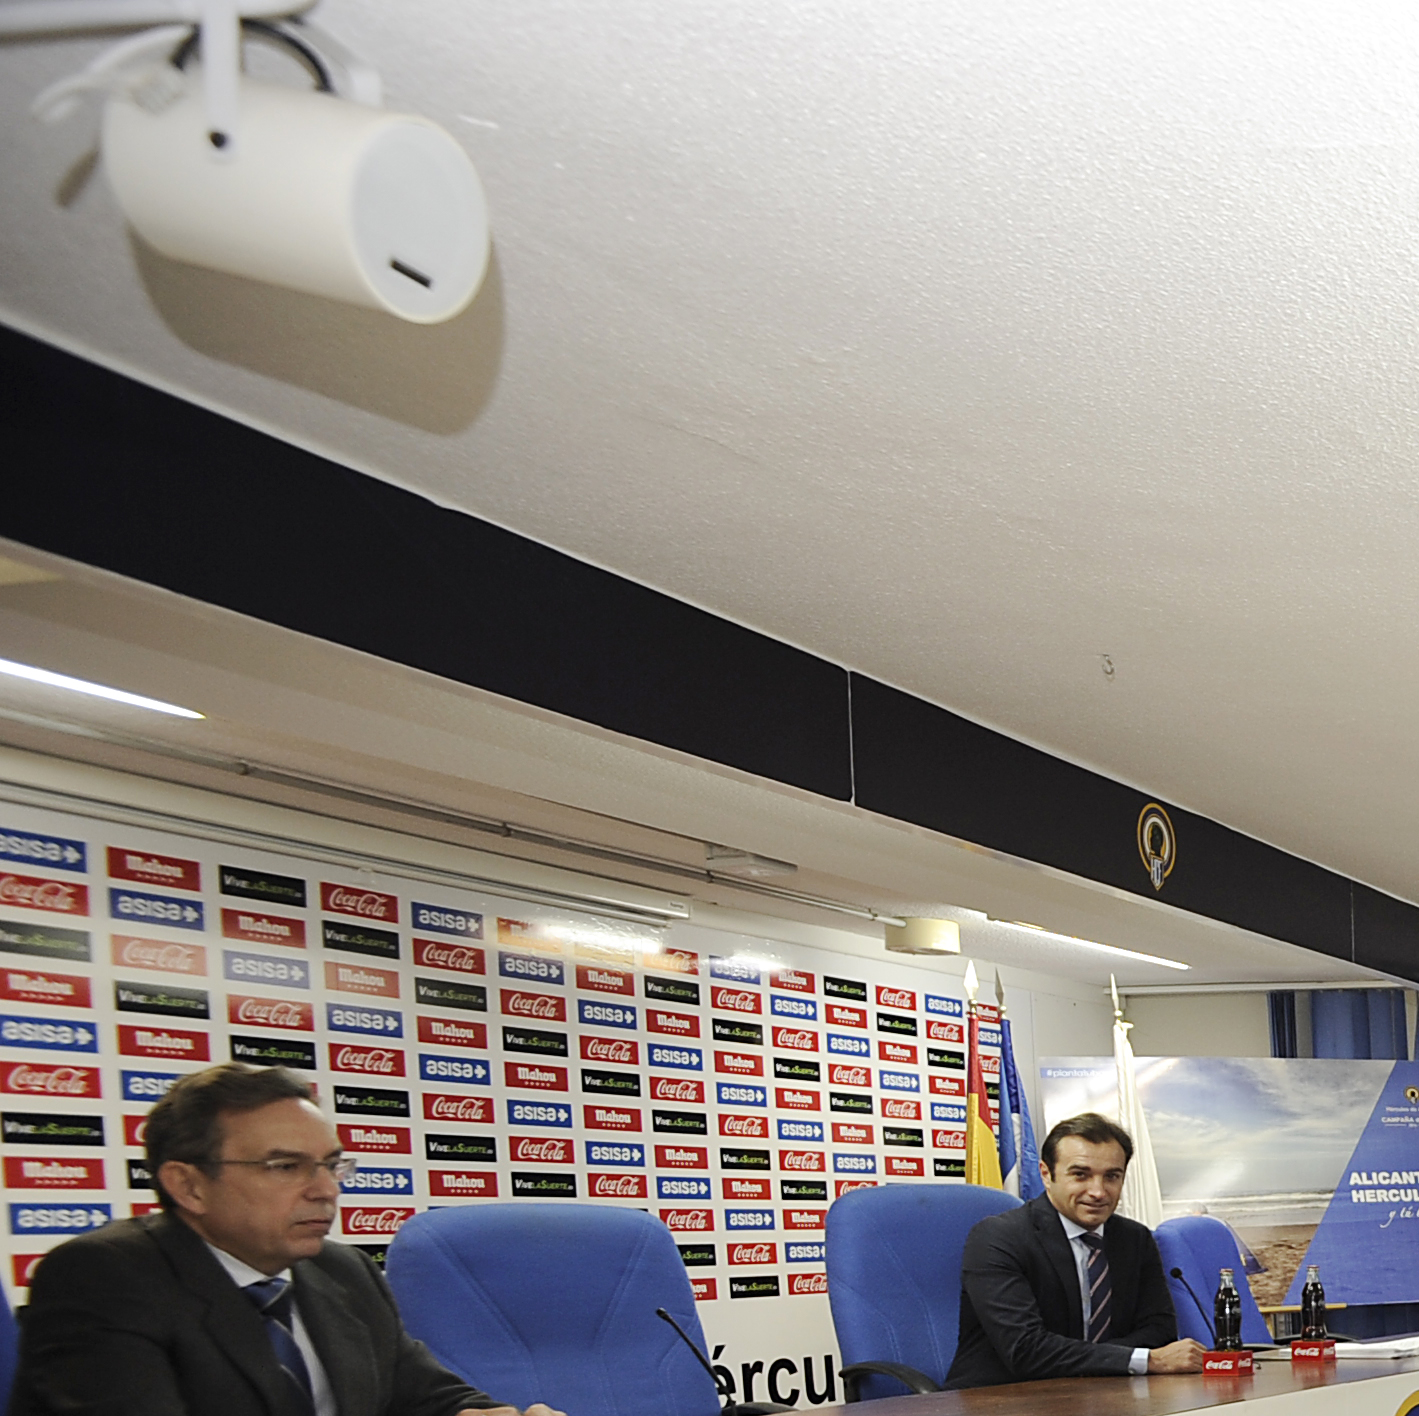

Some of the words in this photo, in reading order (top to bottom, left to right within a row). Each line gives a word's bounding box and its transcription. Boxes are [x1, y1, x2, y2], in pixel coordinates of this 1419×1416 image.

[125, 854, 184, 878] Mahou
[117, 896, 183, 921] asisa
[237, 915, 291, 937] Mahou
[419, 909, 468, 933] asisa
[232, 957, 287, 981] asisa
[505, 958, 548, 977] asisa
[8, 973, 74, 995] Mahou
[337, 967, 386, 990] Mahou
[587, 970, 624, 987] Mahou
[584, 1005, 624, 1023] asisa
[774, 999, 808, 1015] asisa
[332, 1008, 382, 1031] asisa
[656, 1014, 691, 1030] Mahou
[1, 1021, 77, 1044] asisa
[430, 1022, 475, 1039] Mahou
[135, 1030, 194, 1050] Mahou
[830, 1037, 861, 1053] asisa
[652, 1048, 690, 1065] asisa
[426, 1060, 474, 1078] asisa
[517, 1067, 557, 1083] Mahou
[721, 1087, 757, 1102] asisa
[513, 1105, 557, 1122] asisa
[595, 1109, 632, 1124] Mahou
[351, 1128, 397, 1145] Mahou
[781, 1123, 814, 1138] asisa
[591, 1146, 631, 1162] asisa
[665, 1148, 699, 1162] Mahou
[22, 1161, 87, 1179] Mahou
[836, 1157, 868, 1170] asisa
[442, 1174, 486, 1189] Mahou
[662, 1181, 700, 1195] asisa
[18, 1209, 89, 1228] asisa
[730, 1213, 763, 1226] asisa
[1379, 1210, 1397, 1229] y
[1400, 1206, 1414, 1218] tú
[789, 1246, 819, 1258] asisa
